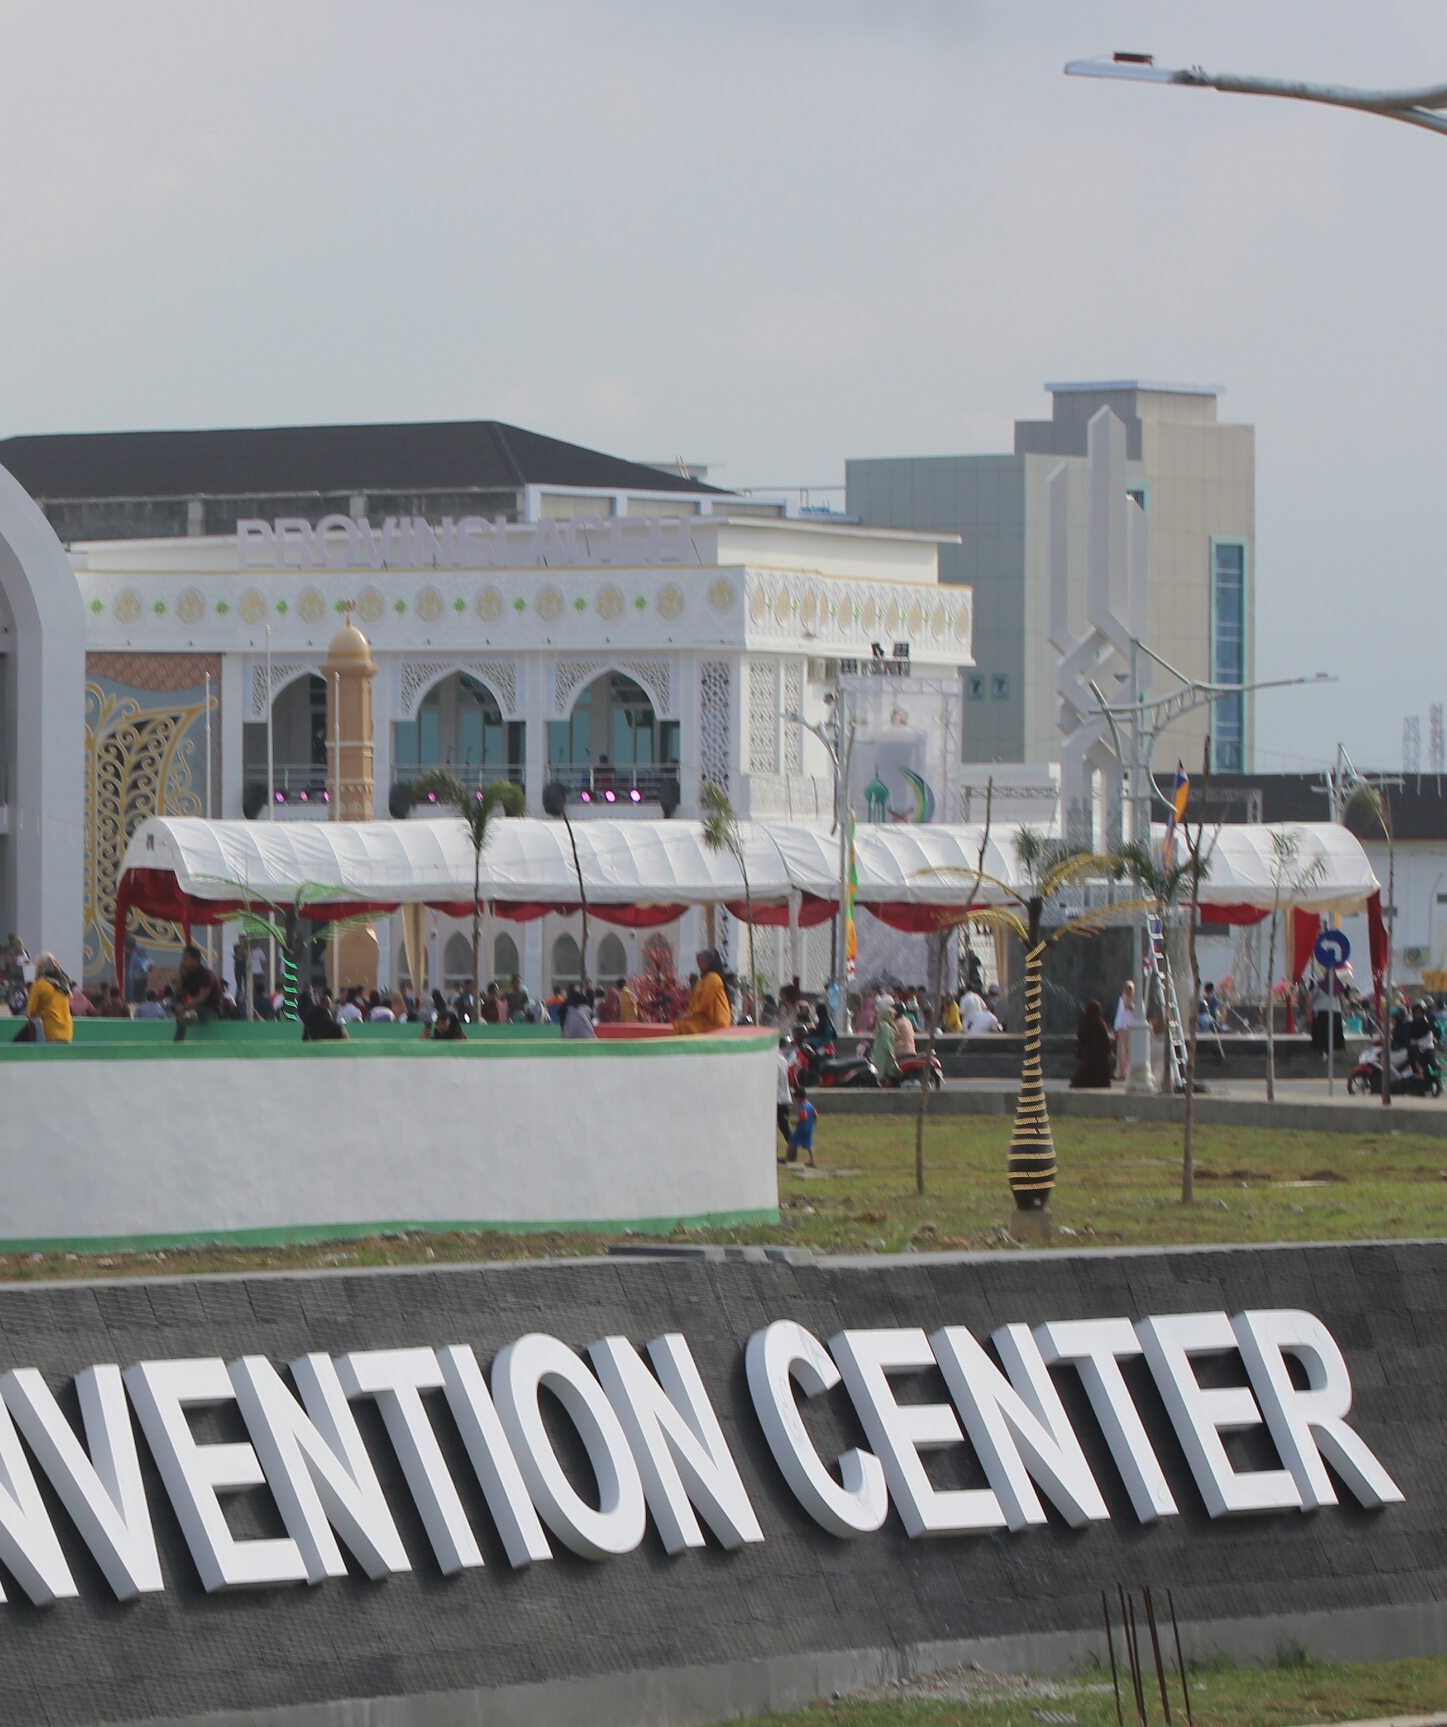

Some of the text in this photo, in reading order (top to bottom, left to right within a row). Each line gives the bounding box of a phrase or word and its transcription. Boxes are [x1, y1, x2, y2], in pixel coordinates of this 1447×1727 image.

[236, 513, 691, 569] PROVINSI ACEH
[745, 1308, 1407, 1539] CENTER
